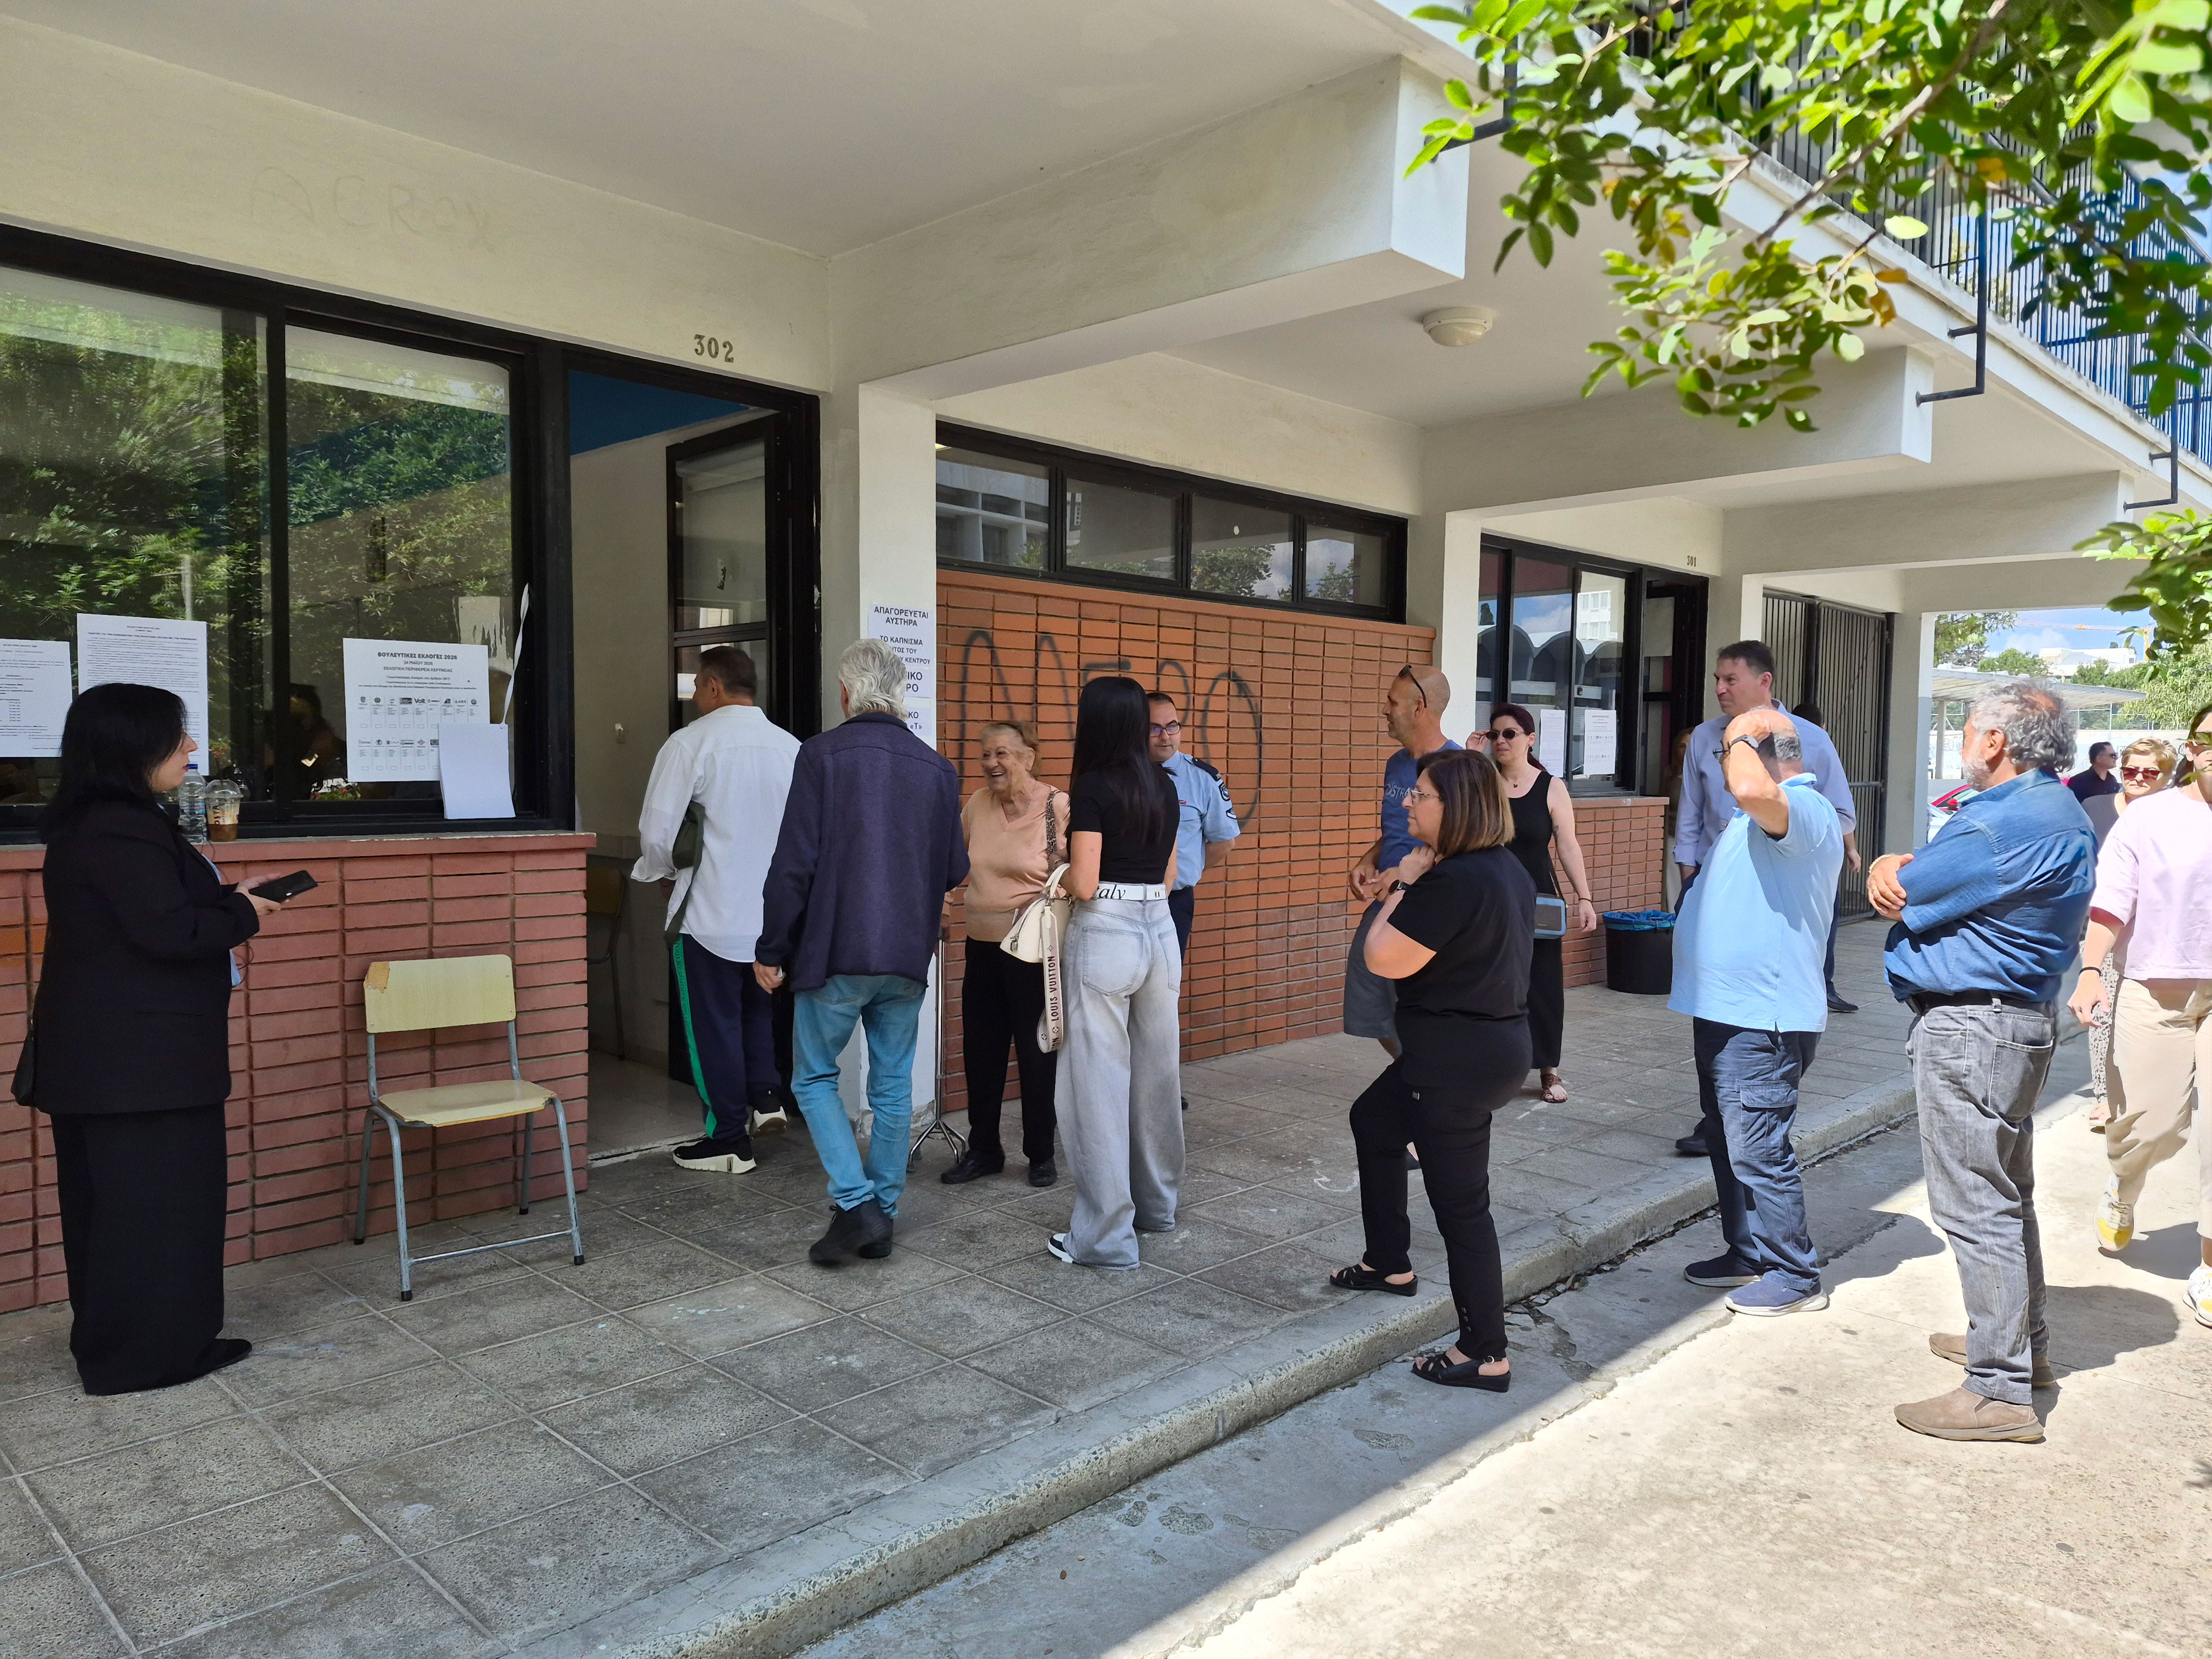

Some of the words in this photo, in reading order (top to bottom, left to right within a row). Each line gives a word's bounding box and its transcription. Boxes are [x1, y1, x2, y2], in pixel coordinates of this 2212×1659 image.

[693, 333, 734, 363] 302
[1687, 555, 1697, 567] 301
[874, 606, 929, 619] ΑΠΑΓΟΡΕΥΕΤΑΙ
[885, 617, 918, 627] ΑΥΣΤΗΡΑ
[890, 637, 924, 646] ΚΑΠΝΙΣΜΑ
[212, 805, 221, 825] OSTA
[1047, 956, 1057, 993] VUITTON
[1050, 997, 1059, 1021] LOUIS
